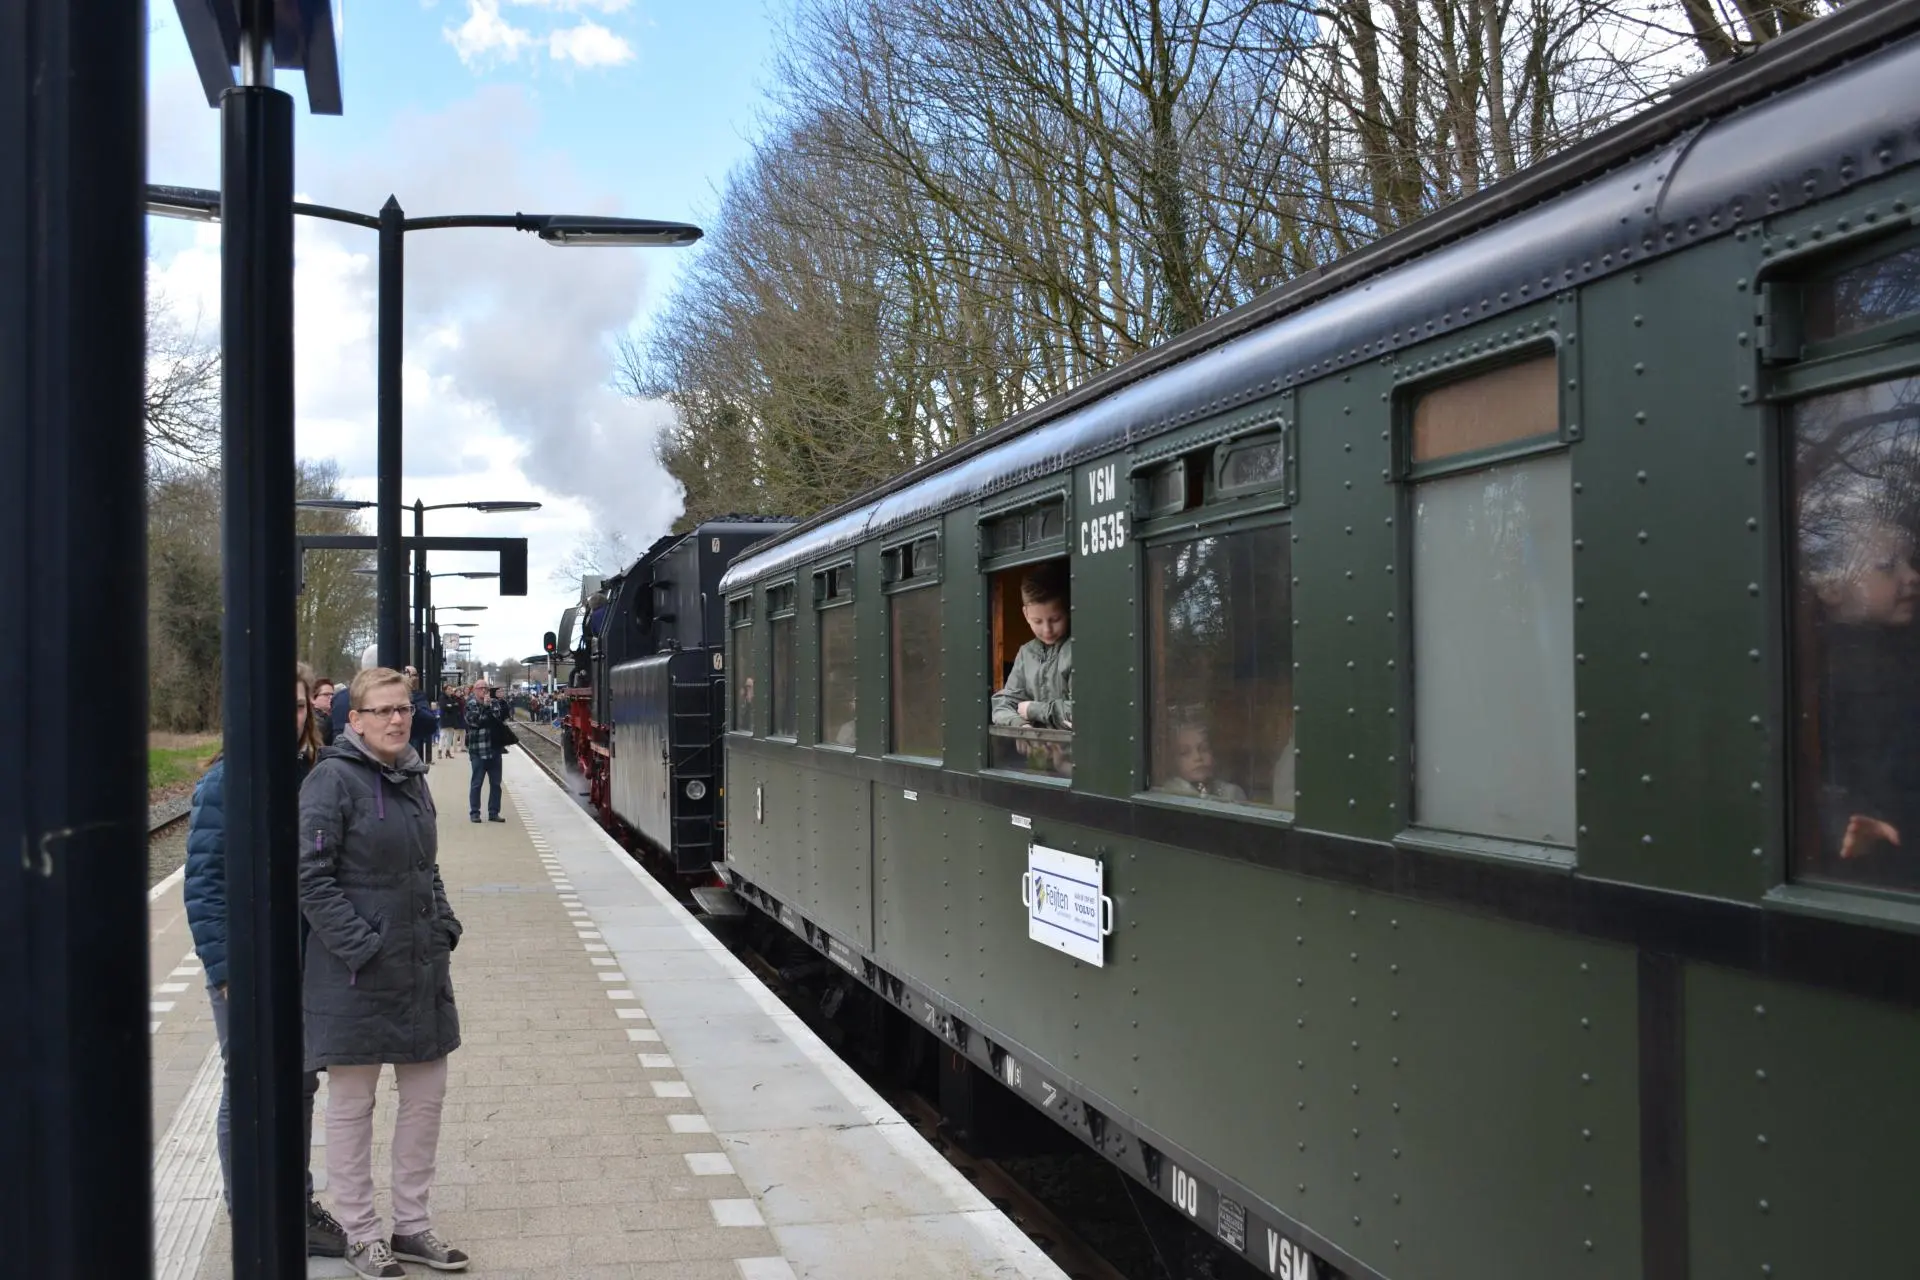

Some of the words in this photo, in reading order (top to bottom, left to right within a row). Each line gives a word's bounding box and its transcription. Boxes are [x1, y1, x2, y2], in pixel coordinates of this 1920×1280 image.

[1088, 464, 1115, 506] VSM
[1081, 521, 1089, 556] C
[1091, 511, 1125, 554] 8535
[1074, 902, 1096, 918] VOLVO
[1172, 1164, 1198, 1217] 100
[1267, 1228, 1310, 1280] VSM
